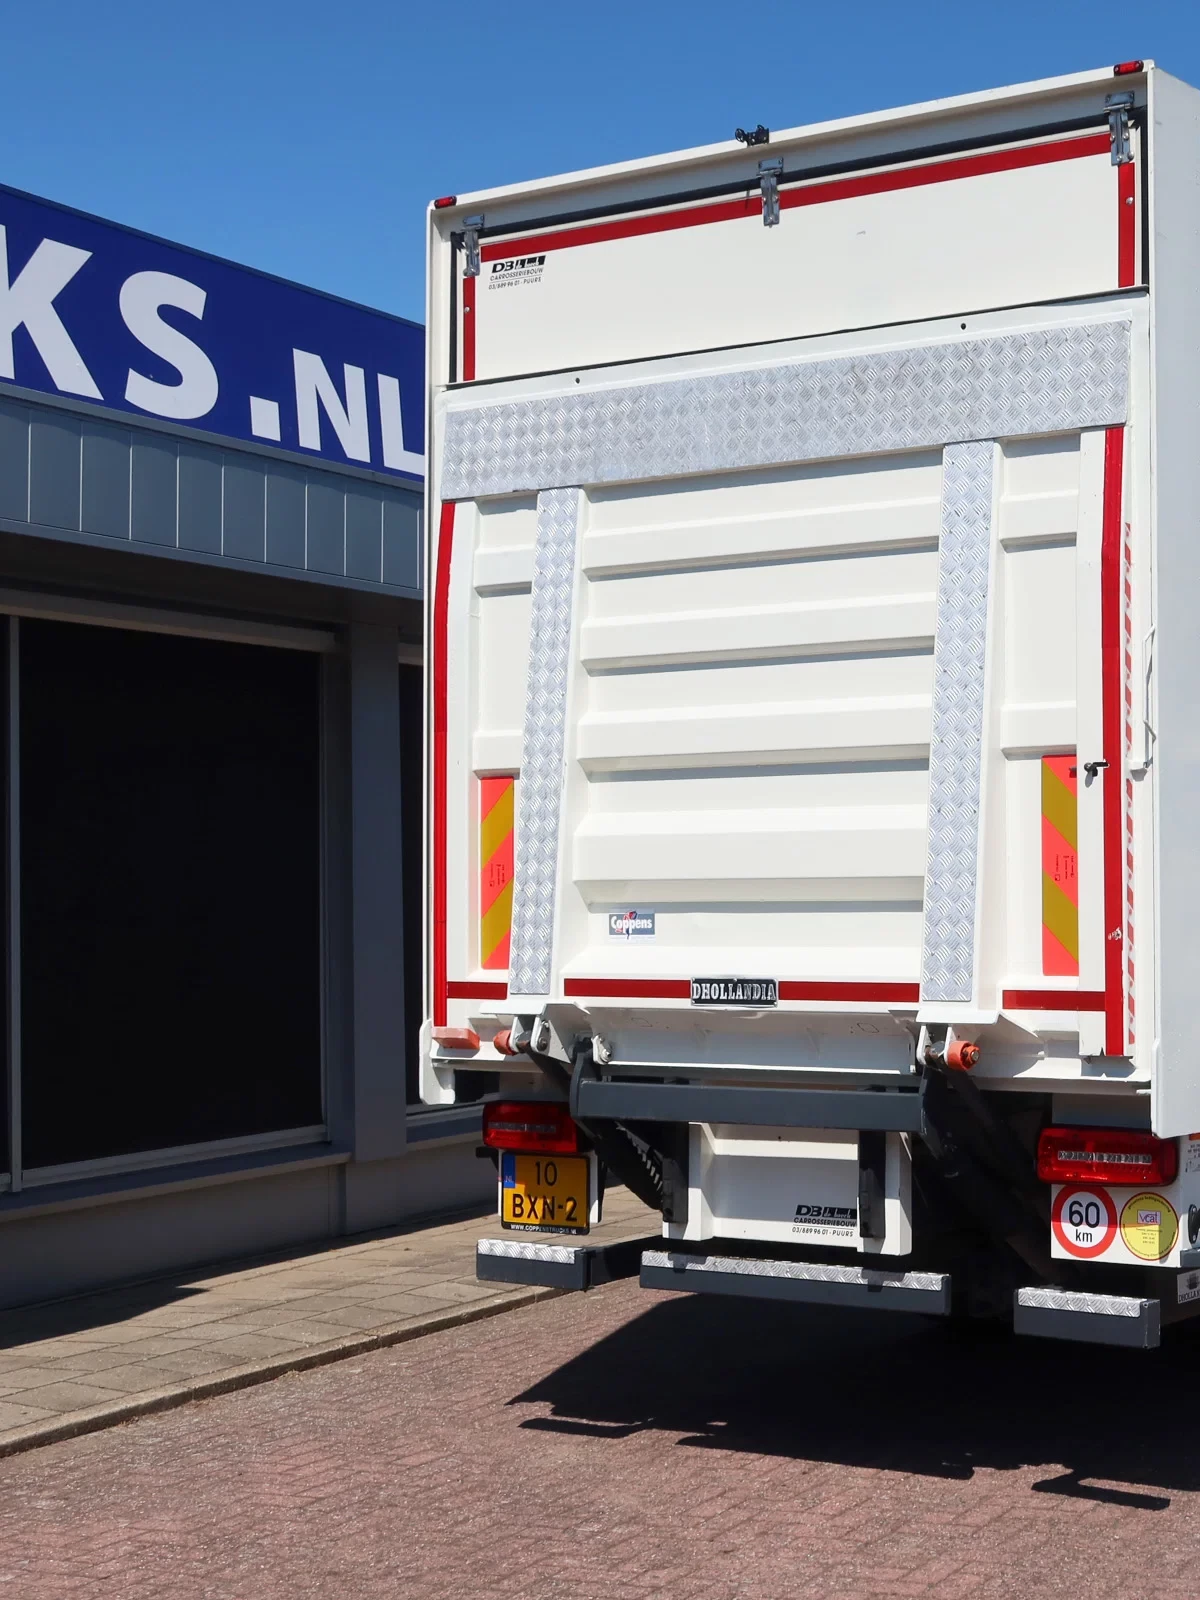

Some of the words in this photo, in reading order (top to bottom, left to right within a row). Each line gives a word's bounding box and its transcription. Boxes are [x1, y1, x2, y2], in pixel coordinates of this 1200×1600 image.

[611, 916, 652, 933] Coppens
[692, 983, 776, 1001] DHOLLANDIA
[535, 1161, 558, 1186] 10
[513, 1194, 578, 1222] BXN-2
[795, 1205, 823, 1217] DB
[1069, 1200, 1100, 1228] 60
[792, 1226, 813, 1234] 03/889
[794, 1217, 857, 1227] CARROSSERIEBOUW
[1075, 1229, 1093, 1242] km
